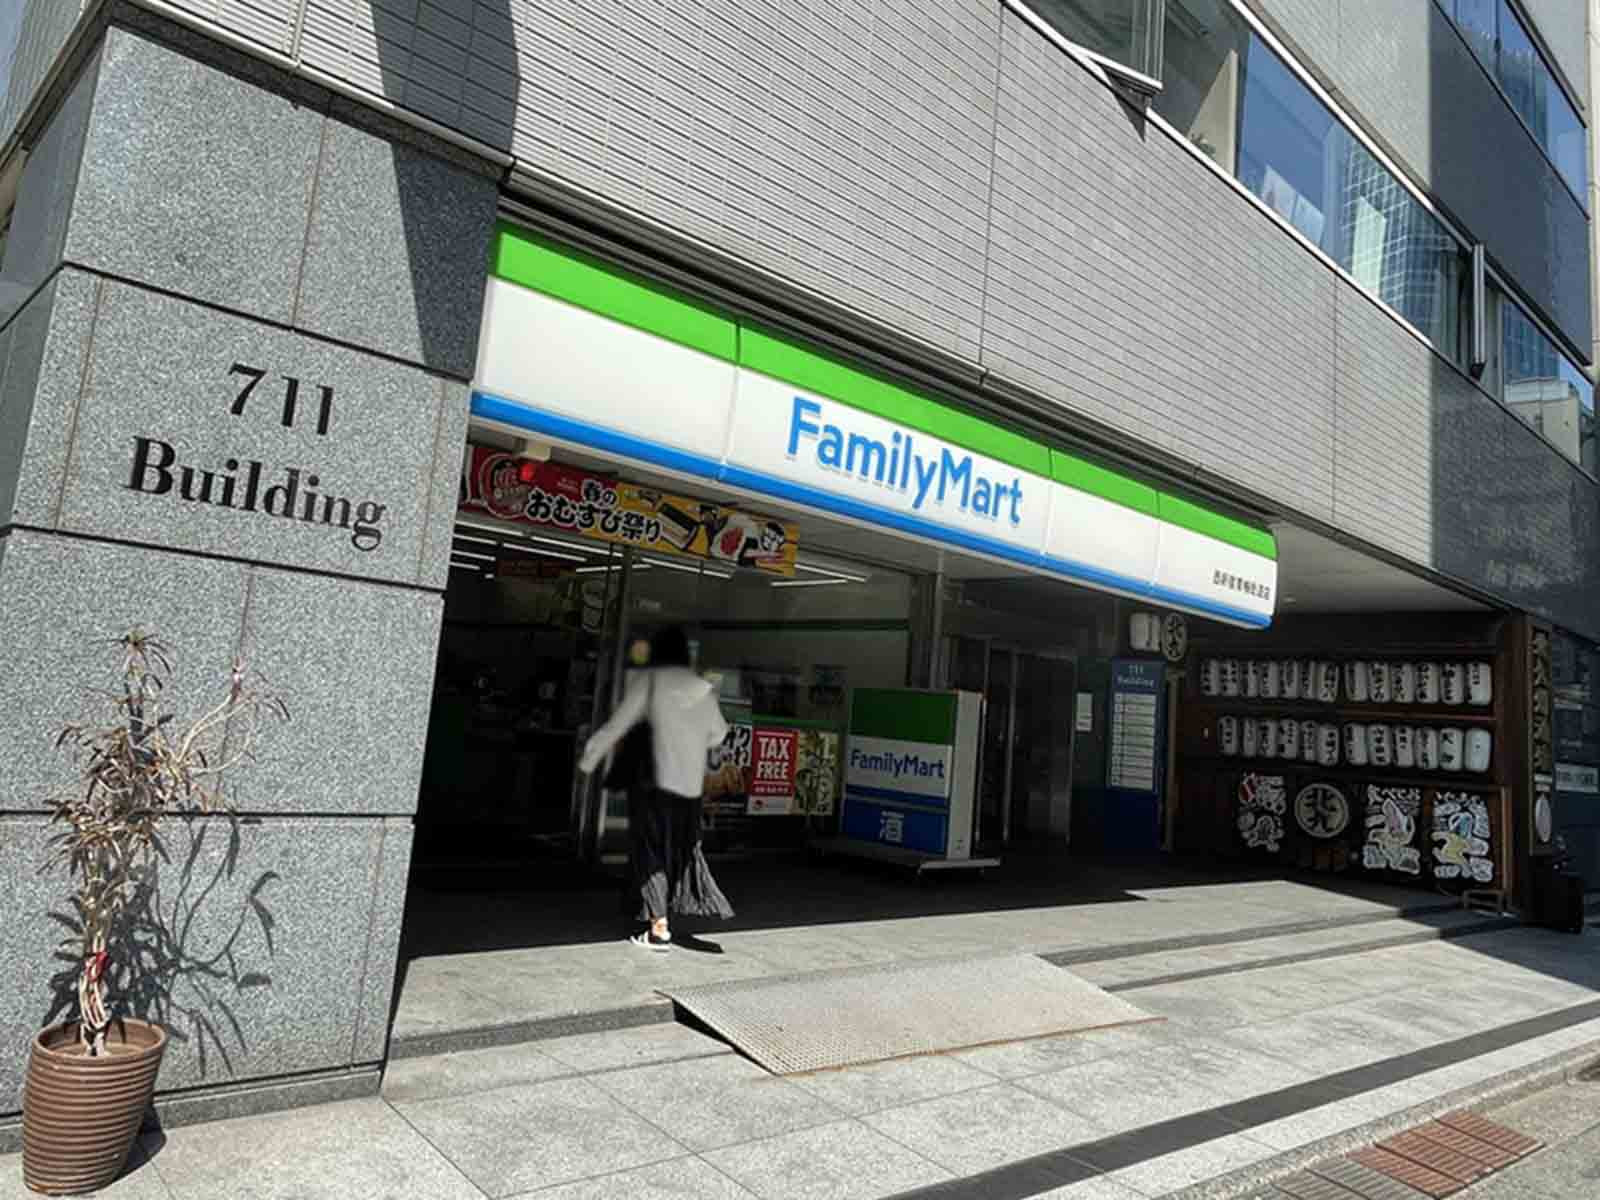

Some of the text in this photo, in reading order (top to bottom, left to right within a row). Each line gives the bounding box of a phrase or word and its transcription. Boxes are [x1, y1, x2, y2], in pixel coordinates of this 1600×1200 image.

[228, 363, 334, 436] 711
[787, 396, 1023, 524] FamilyMart
[121, 435, 386, 551] Building
[525, 488, 661, 543] おむすび祭り
[758, 737, 791, 760] TAX
[850, 749, 945, 779] FamilyMart
[756, 761, 789, 780] FREE
[879, 811, 904, 842] 酒
